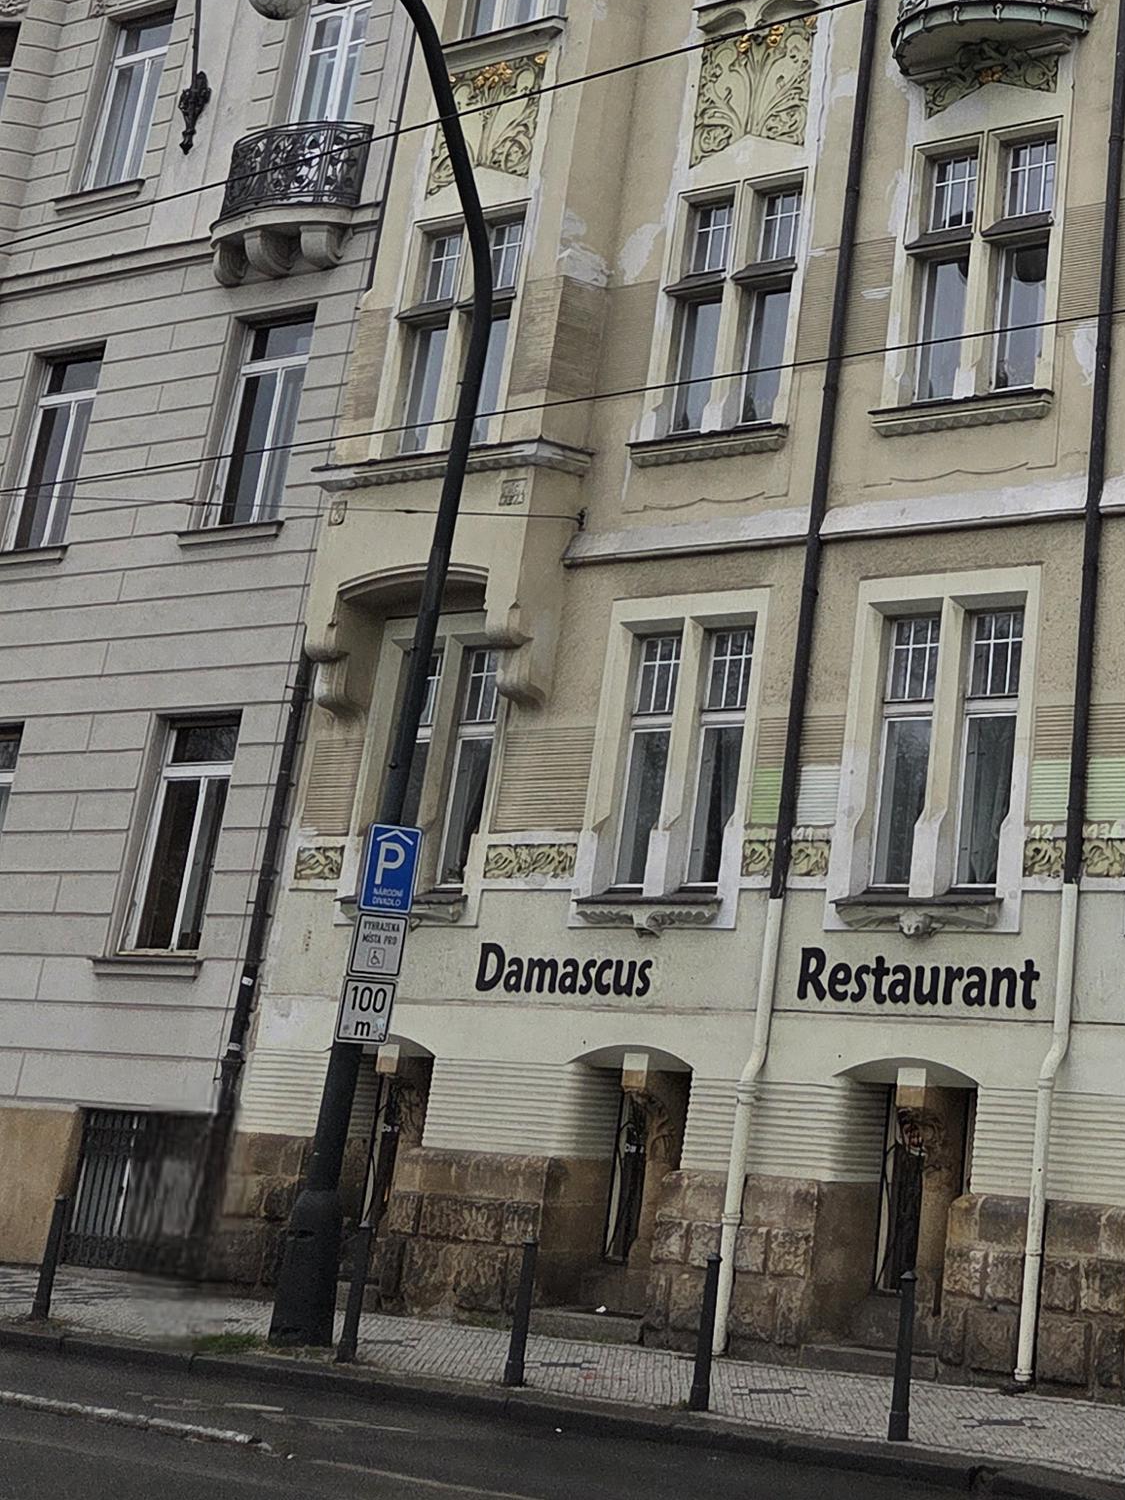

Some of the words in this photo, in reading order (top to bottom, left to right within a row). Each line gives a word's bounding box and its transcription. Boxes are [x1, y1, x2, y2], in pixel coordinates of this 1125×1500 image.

[374, 841, 405, 885] P
[475, 942, 653, 997] Damascus
[797, 947, 1040, 1009] Restaurant
[351, 985, 387, 1013] 100
[354, 1020, 371, 1037] m
